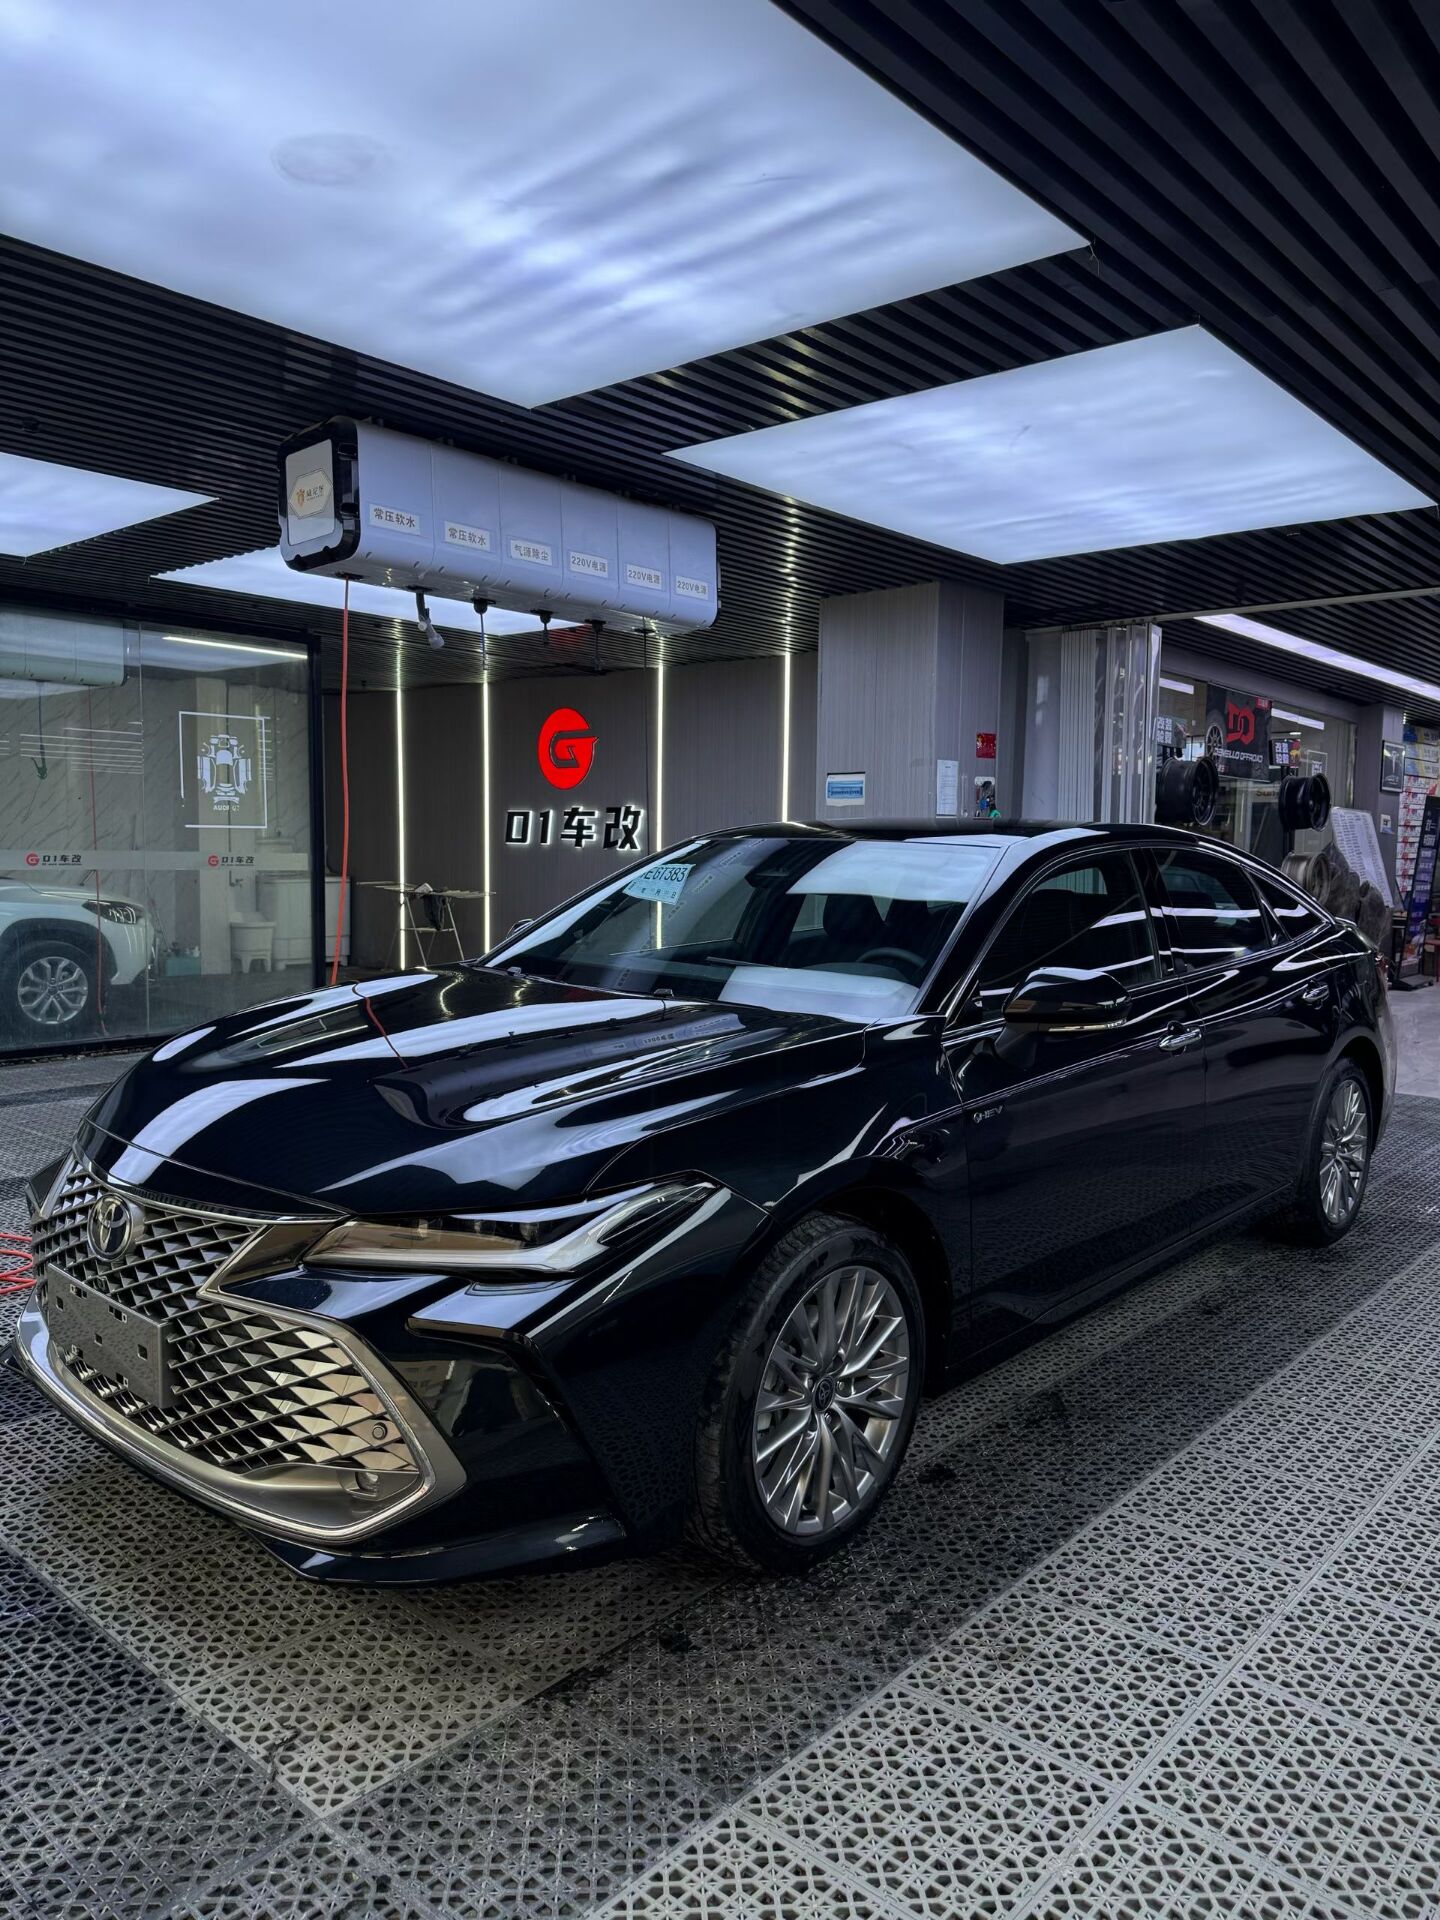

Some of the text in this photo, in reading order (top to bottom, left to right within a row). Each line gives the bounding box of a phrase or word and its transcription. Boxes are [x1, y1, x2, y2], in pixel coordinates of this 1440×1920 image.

[373, 507, 416, 528] 常压软水
[448, 527, 487, 546] 常压软水
[513, 543, 549, 561] 气源除尘
[571, 555, 607, 573] 220V电源
[627, 569, 661, 585] 220V电源
[677, 580, 707, 595] 220V电源
[505, 805, 645, 851] 01车改
